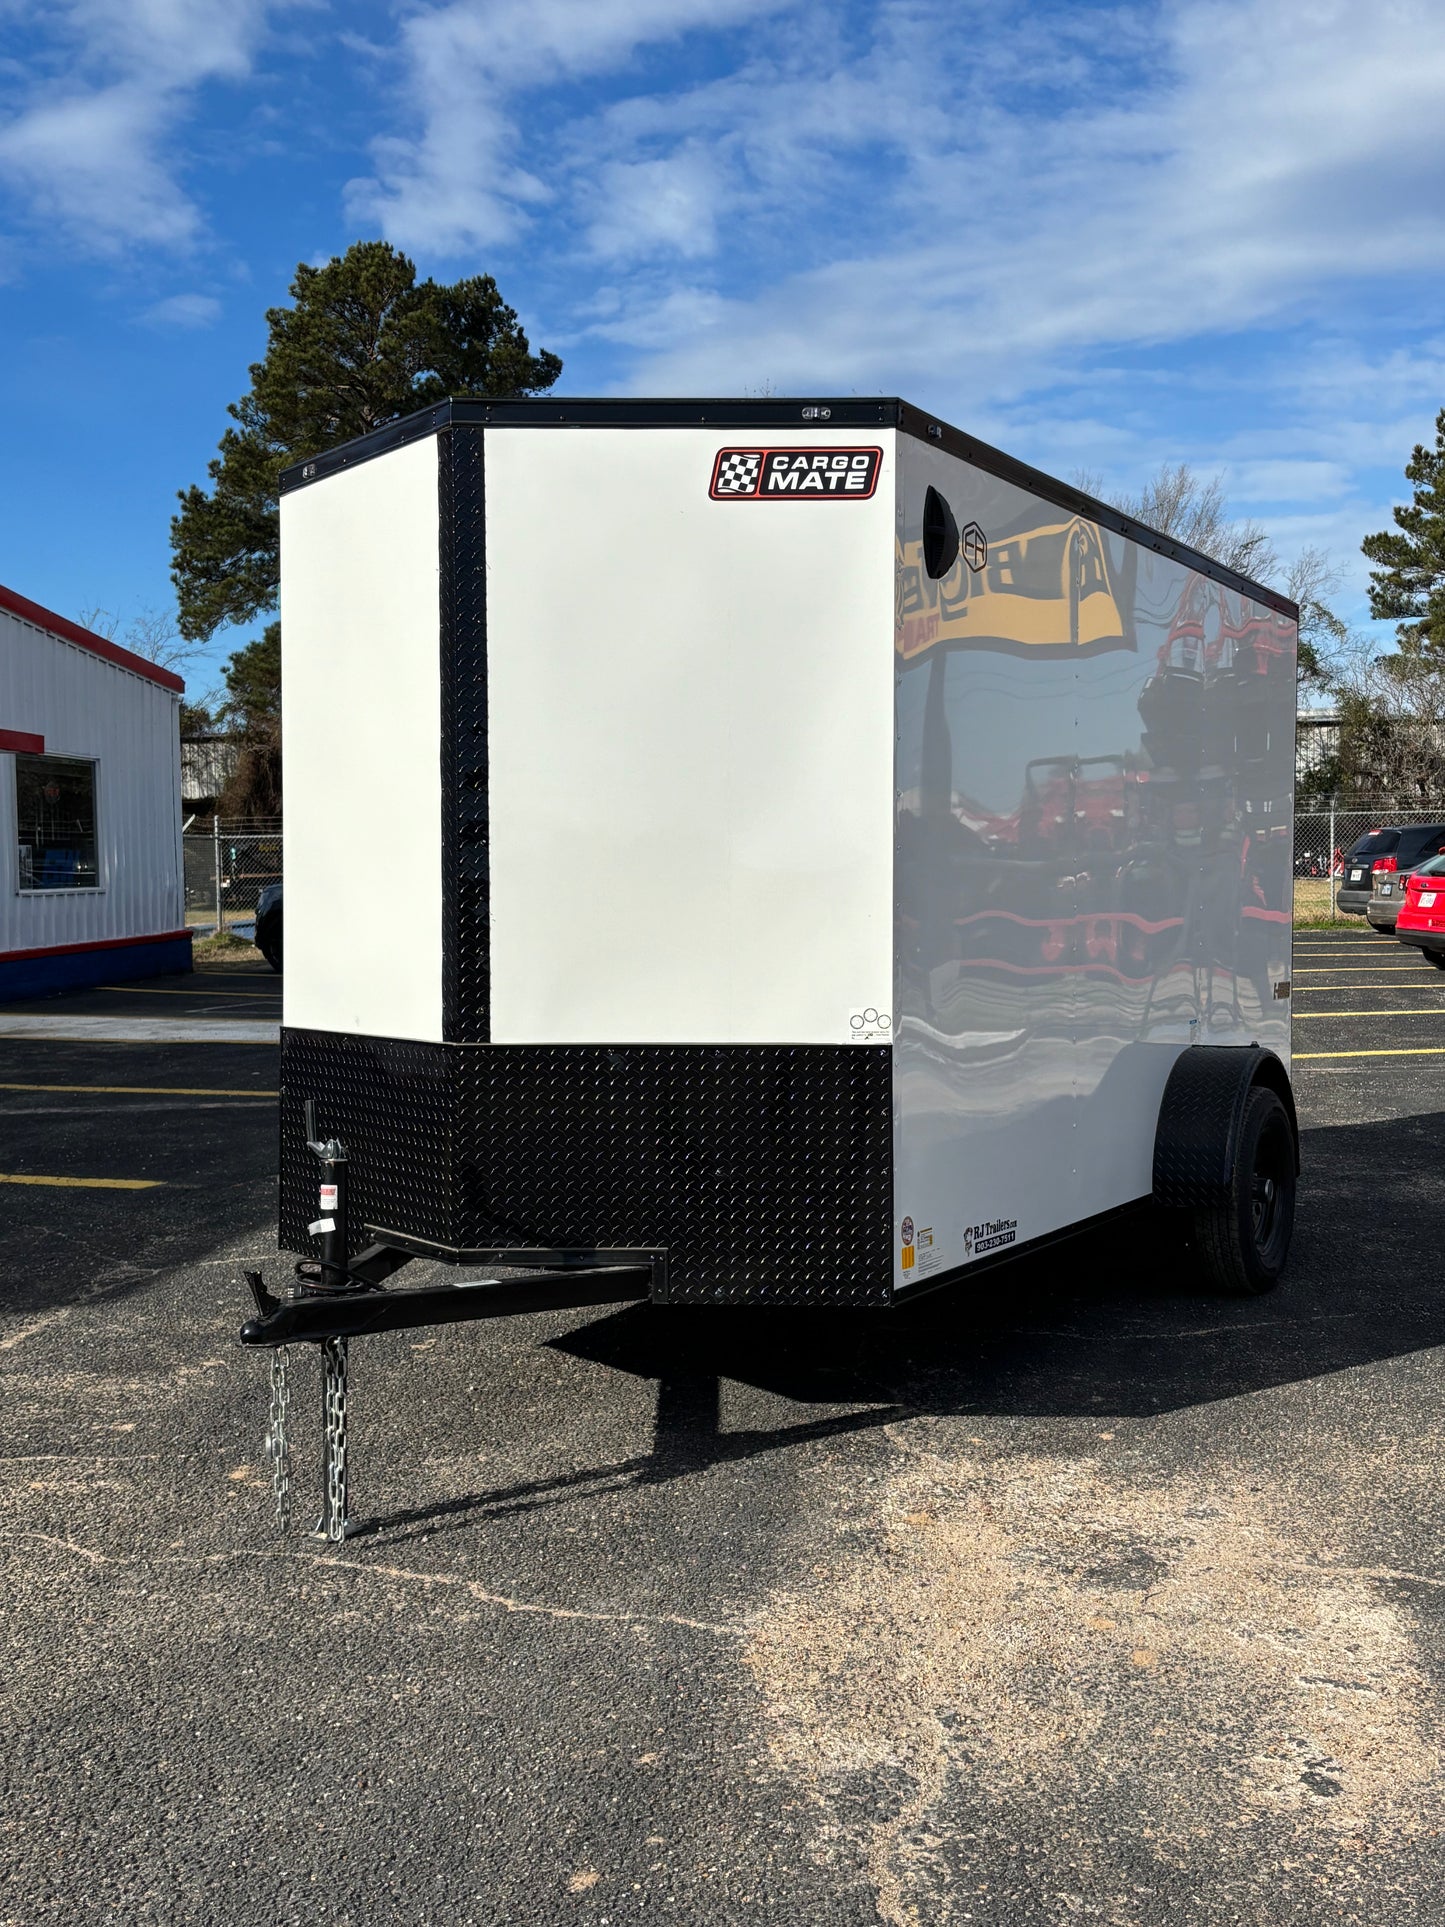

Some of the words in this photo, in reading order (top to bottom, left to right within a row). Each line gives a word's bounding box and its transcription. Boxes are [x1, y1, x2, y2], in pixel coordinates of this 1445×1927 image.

[772, 456, 869, 470] CARGO
[768, 472, 867, 490] MATE
[973, 1223, 985, 1240] RJ
[976, 1232, 1014, 1252] 903-230-7511
